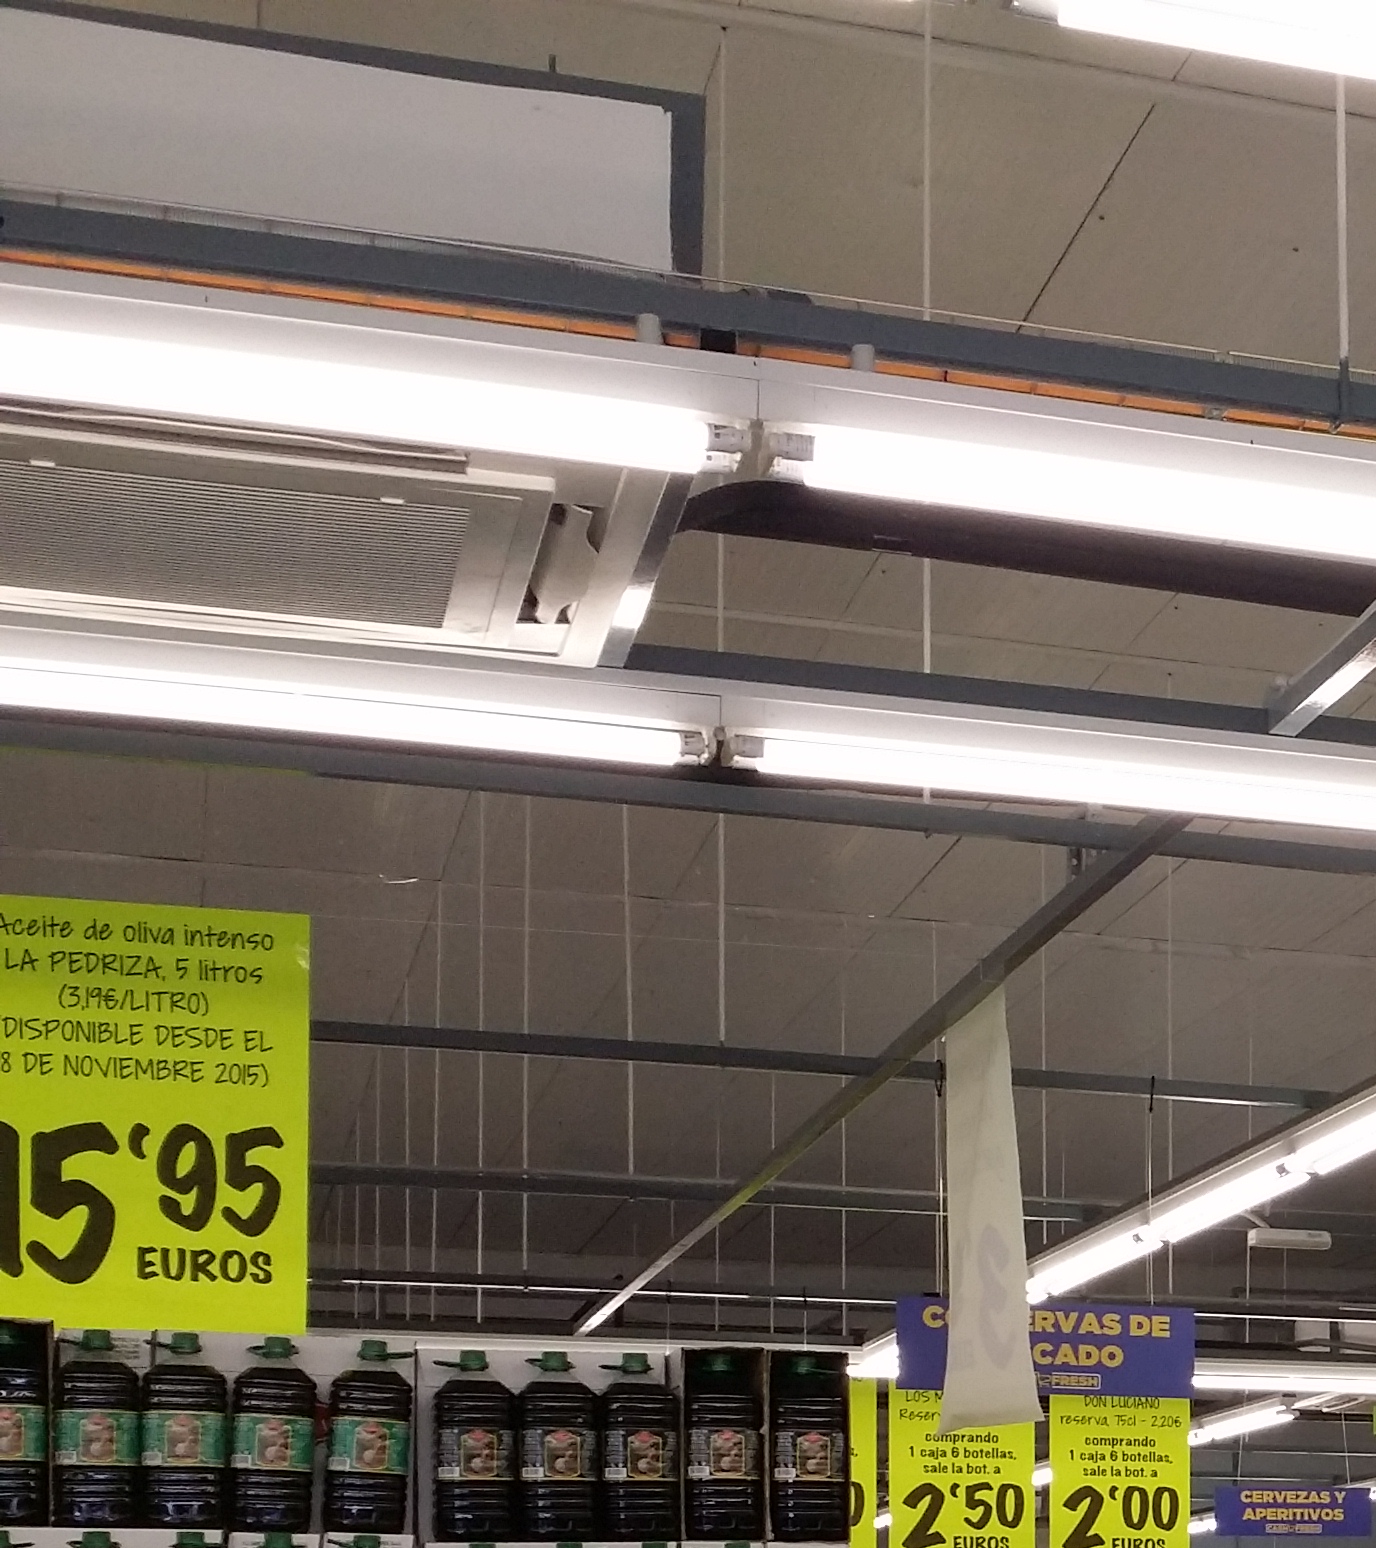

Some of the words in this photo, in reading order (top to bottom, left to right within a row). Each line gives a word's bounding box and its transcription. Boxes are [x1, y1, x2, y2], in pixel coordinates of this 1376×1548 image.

[84, 918, 112, 940] de
[123, 922, 175, 945] oliva
[184, 925, 274, 951] intenso
[5, 948, 38, 972] LA
[49, 951, 166, 981] PEDRIZA,
[175, 958, 188, 980] 5
[199, 960, 263, 984] litros
[2, 1017, 144, 1045] DISPONIBLE
[156, 1025, 234, 1050] DESDE
[244, 1030, 273, 1052] EL
[23, 1053, 54, 1075] DE
[64, 1055, 204, 1082] NOVIEMBRE
[215, 1063, 269, 1088] 2015)
[137, 1246, 272, 1283] EUROS
[1130, 1315, 1170, 1337] DE
[1033, 1343, 1124, 1367] CADO
[1052, 1377, 1099, 1386] FRESH
[906, 1391, 930, 1402] LOS
[1085, 1396, 1106, 1407] DON
[1112, 1396, 1159, 1409] LUCIANO
[1060, 1415, 1109, 1426] reserva
[925, 1432, 998, 1445] comprando
[1085, 1436, 1155, 1448] comprando
[909, 1446, 914, 1457] 1
[920, 1449, 947, 1460] caja
[952, 1448, 959, 1458] 6
[1069, 1450, 1074, 1460] 1
[1080, 1452, 1105, 1462] caja
[1110, 1451, 1117, 1461] 6
[923, 1462, 948, 1473] sale
[952, 1462, 962, 1473] la
[966, 1464, 989, 1474] bot.
[993, 1465, 1001, 1474] a
[1083, 1466, 1106, 1476] sale
[1111, 1466, 1121, 1477] la
[1125, 1467, 1147, 1478] bot.
[1151, 1469, 1158, 1477] a
[1240, 1490, 1330, 1503] CERVEZAS
[1334, 1492, 1346, 1503] Y
[1243, 1508, 1344, 1521] APERITIVOS
